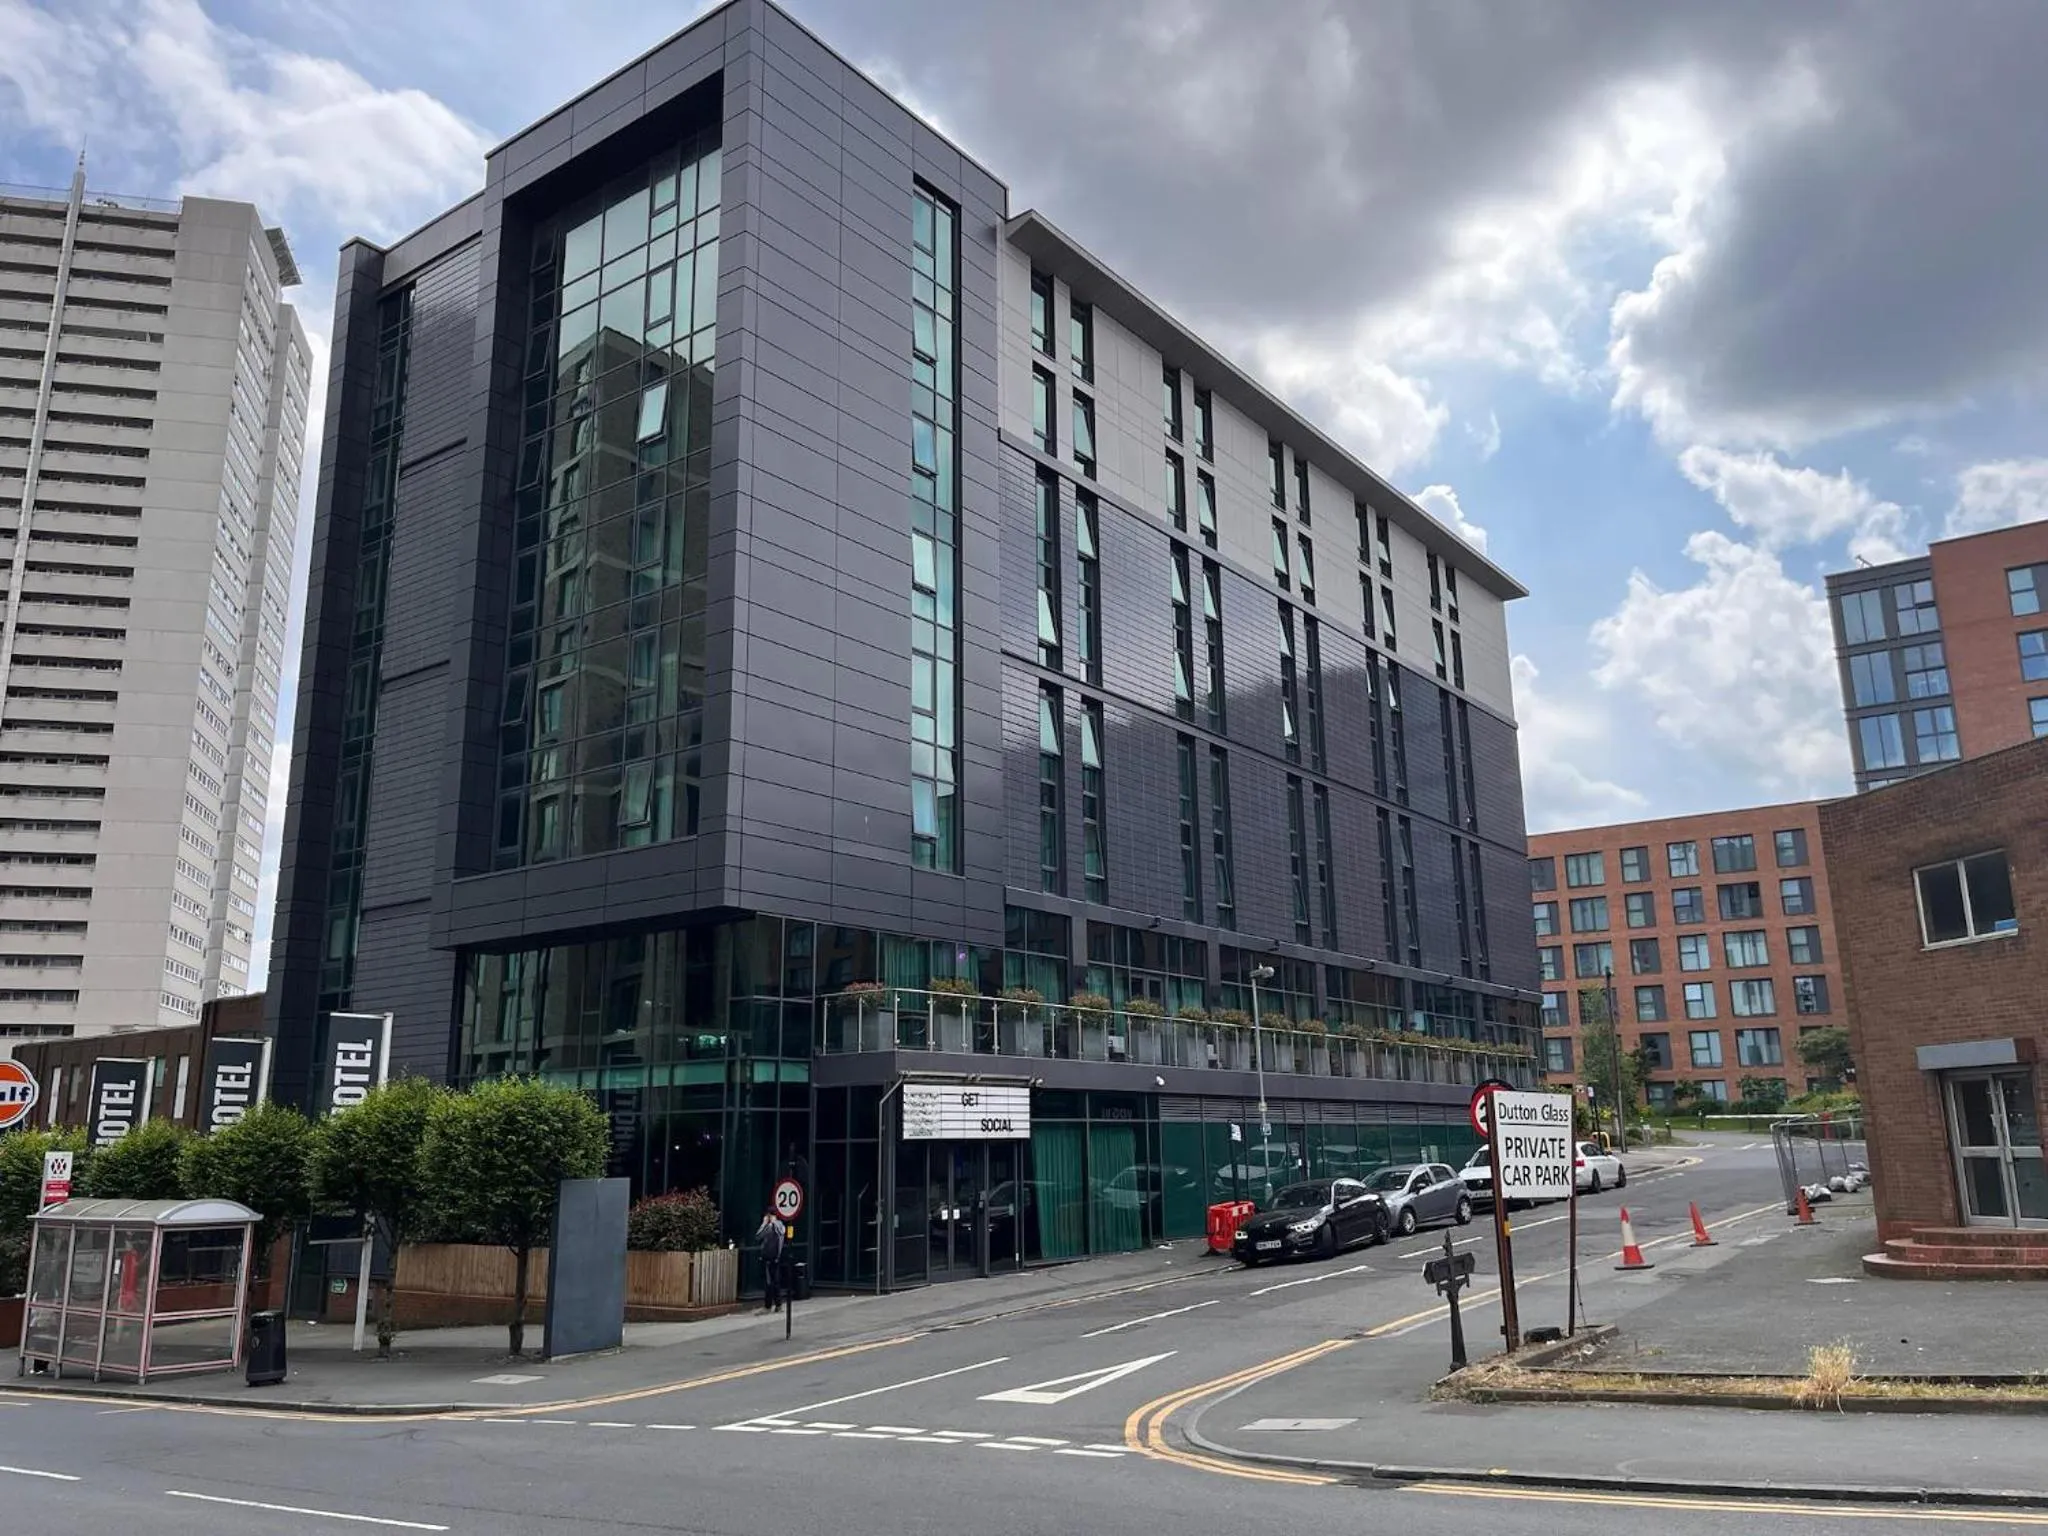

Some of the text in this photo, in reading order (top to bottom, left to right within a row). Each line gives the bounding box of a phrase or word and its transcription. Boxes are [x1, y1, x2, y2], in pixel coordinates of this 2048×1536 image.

[331, 1039, 373, 1115] OTEL
[210, 1062, 252, 1133] OTEL
[961, 1092, 980, 1107] GET
[1498, 1103, 1569, 1122] Dutton Glass
[981, 1118, 1014, 1132] SOCIAL
[1505, 1137, 1566, 1159] PRIVATE
[1503, 1165, 1570, 1186] CAR PARK
[778, 1190, 798, 1208] 20
